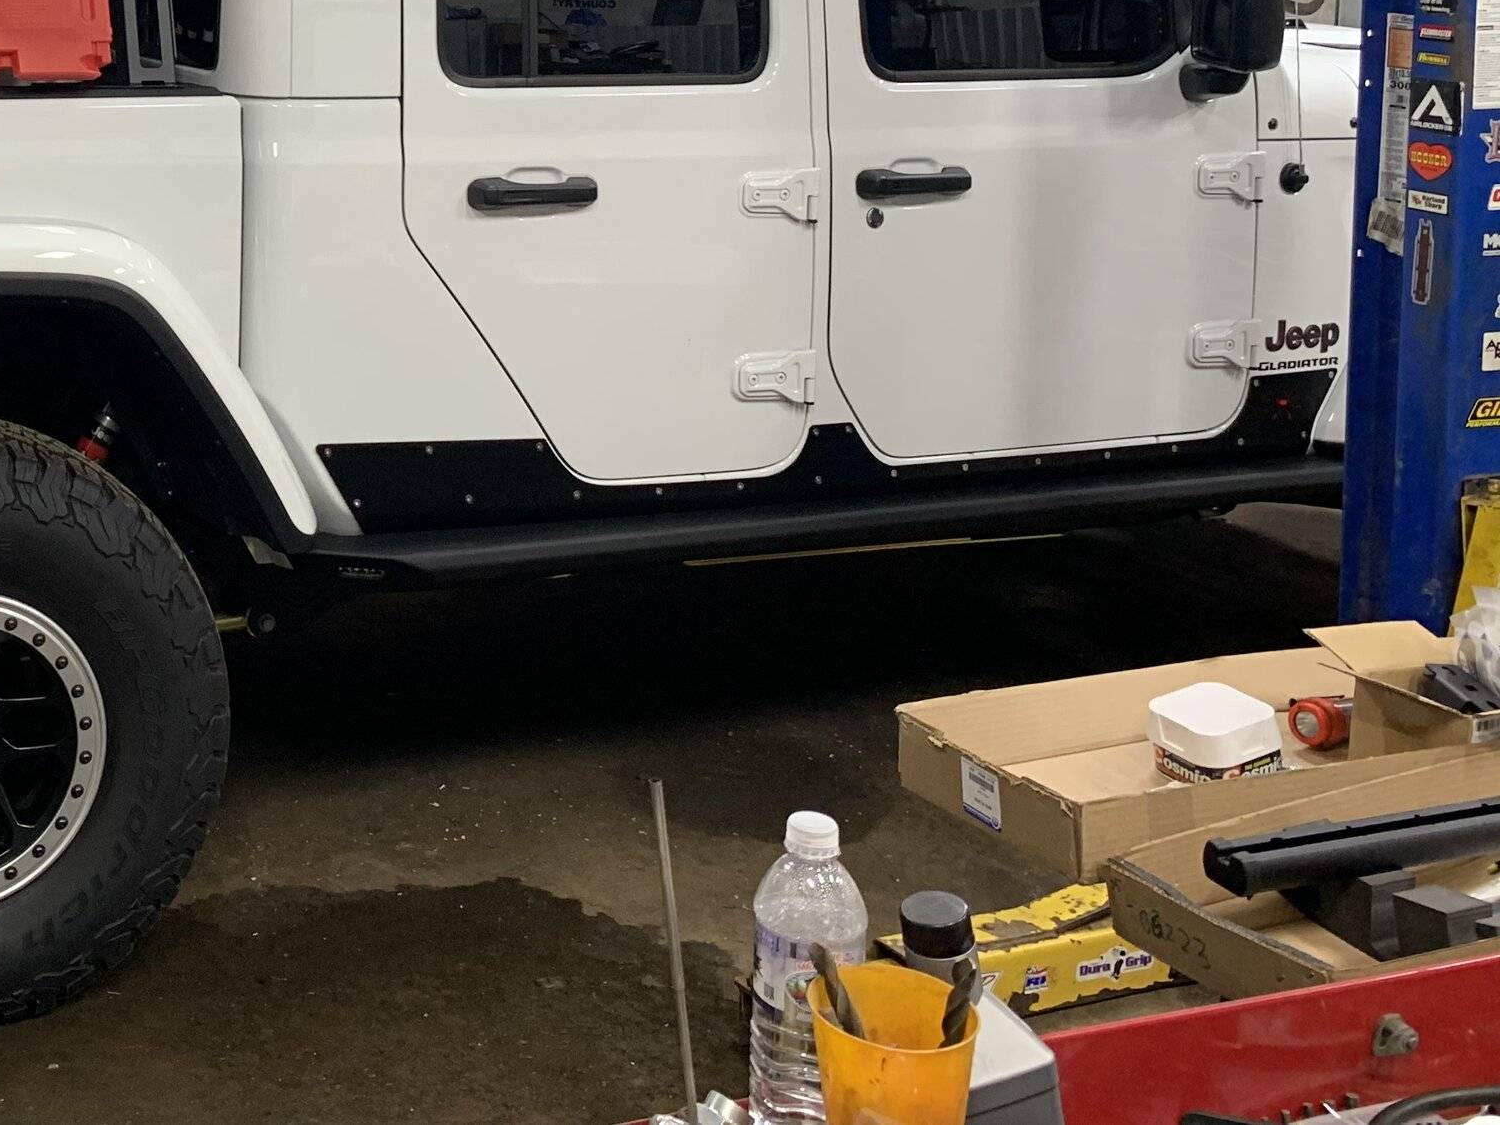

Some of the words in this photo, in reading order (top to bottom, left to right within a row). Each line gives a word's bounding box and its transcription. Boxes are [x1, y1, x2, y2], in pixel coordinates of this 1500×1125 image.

[1410, 150, 1448, 167] HOOKER
[1265, 319, 1340, 353] Jeep
[1258, 356, 1339, 372] GLADIATOR
[1079, 961, 1111, 977] Dura
[1125, 953, 1152, 968] Grip
